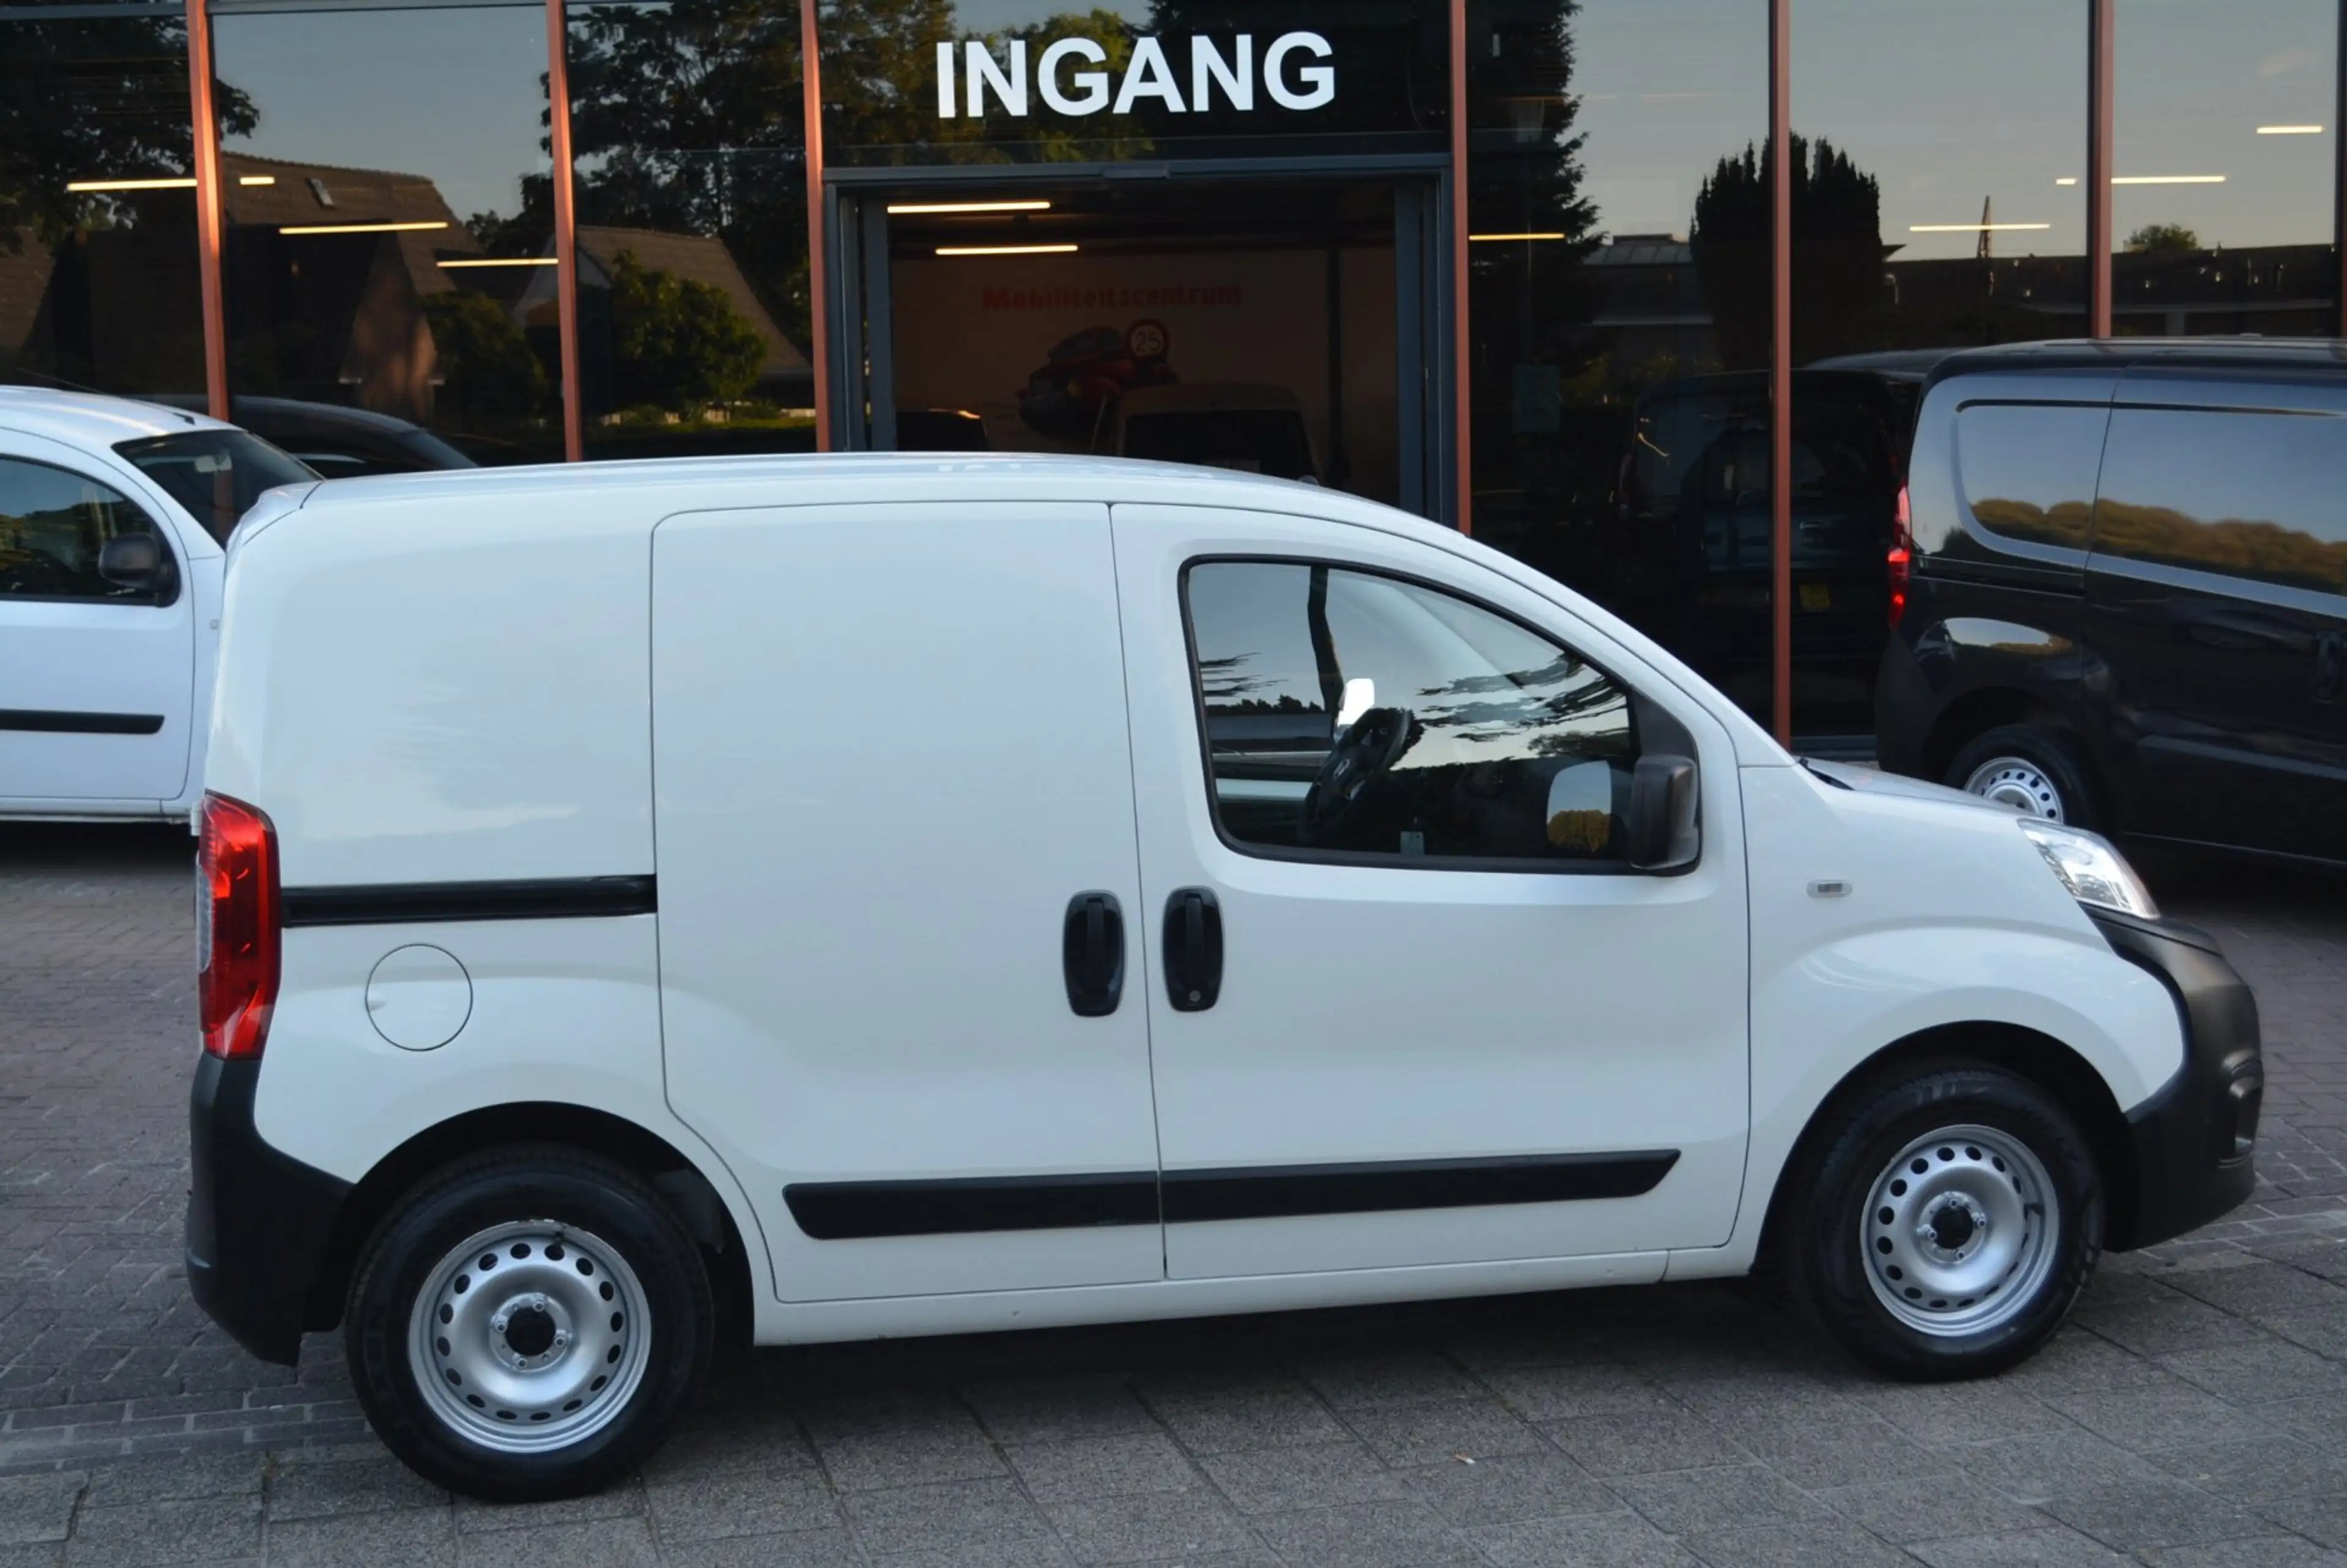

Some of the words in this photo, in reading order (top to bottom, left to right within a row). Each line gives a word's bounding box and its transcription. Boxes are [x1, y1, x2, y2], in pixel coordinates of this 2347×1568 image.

[937, 32, 1335, 118] INGANG
[982, 285, 1242, 310] Mobiliteitscentrum
[1135, 331, 1161, 353] 25
